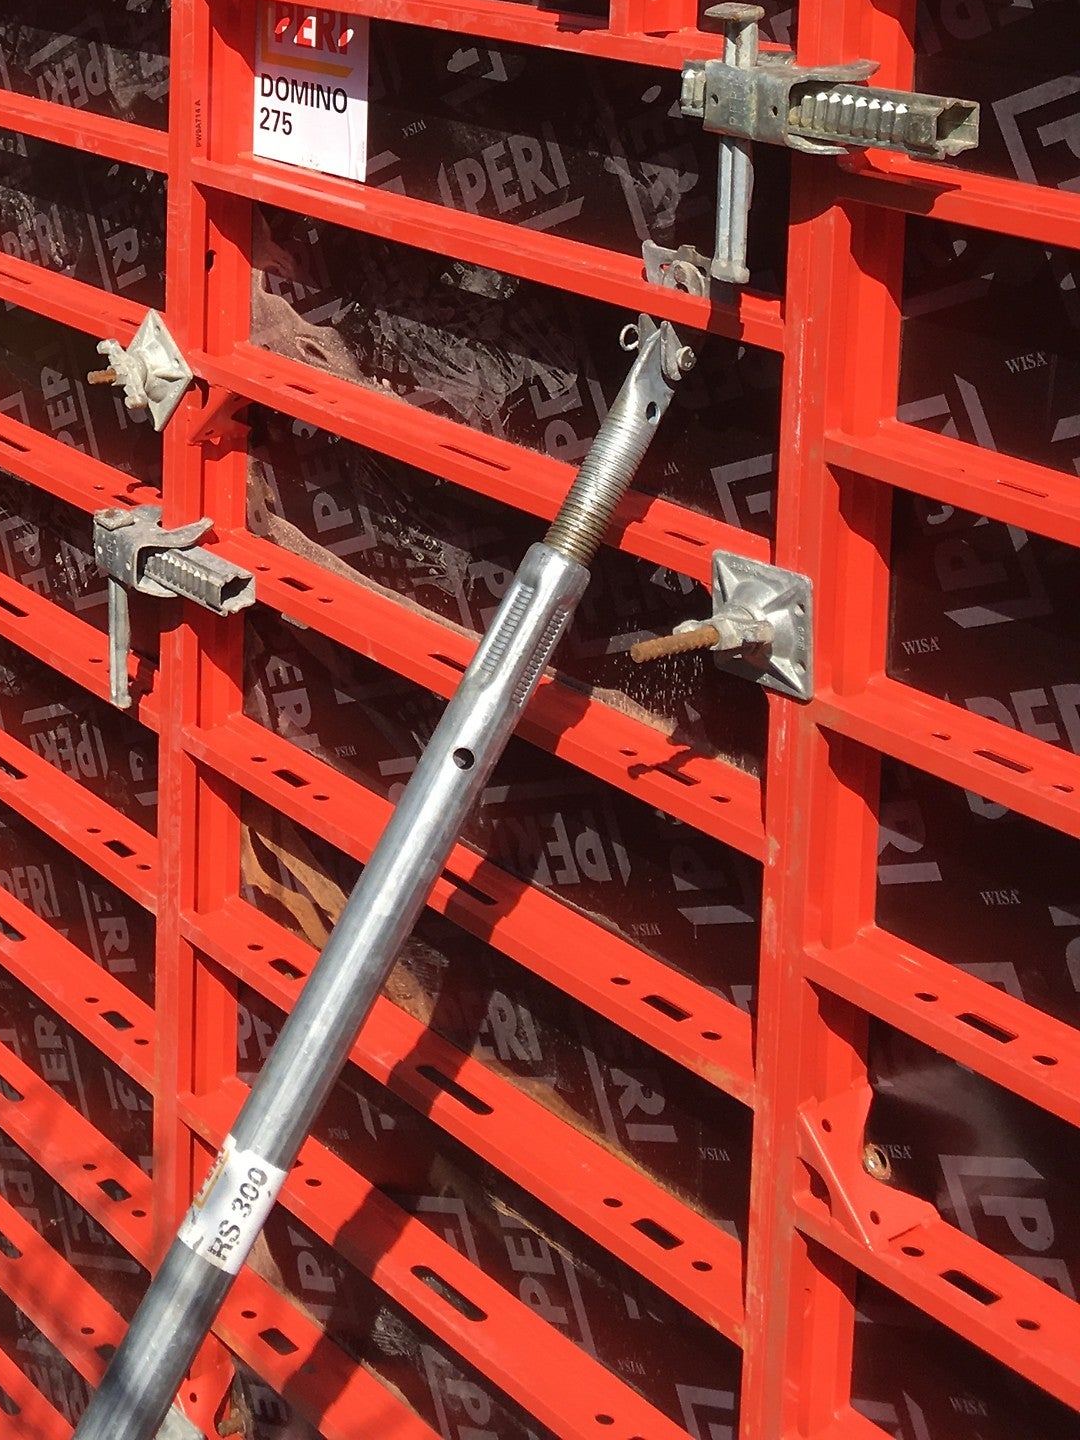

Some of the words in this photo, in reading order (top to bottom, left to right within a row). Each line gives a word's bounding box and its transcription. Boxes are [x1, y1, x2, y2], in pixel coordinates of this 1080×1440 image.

[273, 1, 354, 55] PERI
[259, 73, 348, 114] DOMINO
[259, 107, 293, 136] 275
[453, 122, 571, 215] PERI
[1004, 351, 1047, 375] WISA
[901, 636, 941, 657] WISA
[980, 889, 1021, 907] WISA
[207, 1219, 241, 1261] RS
[231, 1166, 269, 1219] 300
